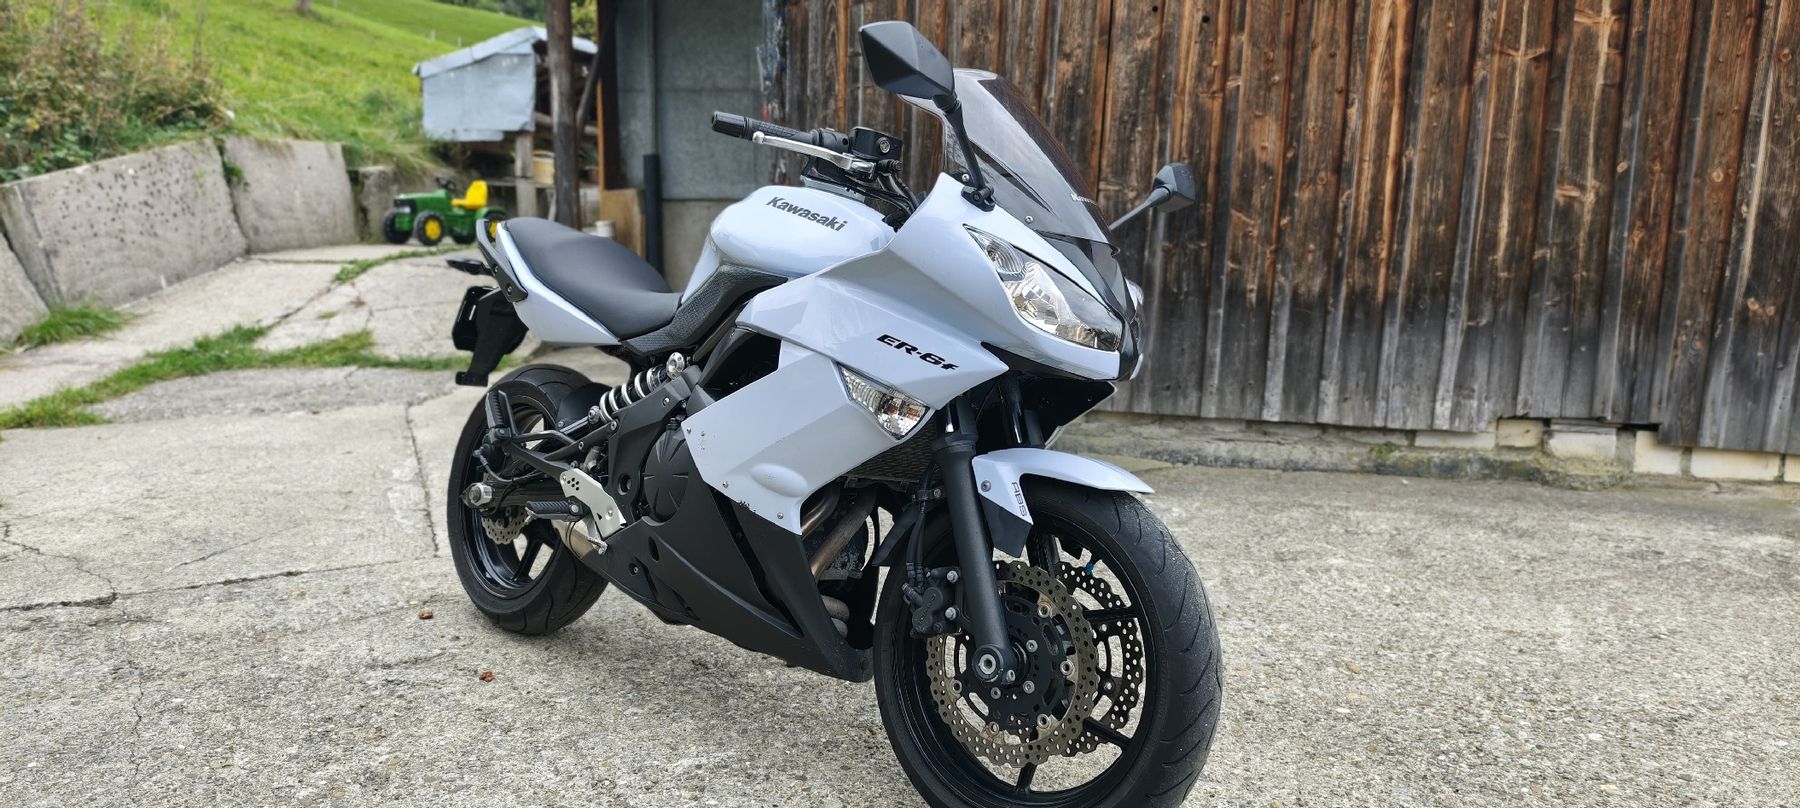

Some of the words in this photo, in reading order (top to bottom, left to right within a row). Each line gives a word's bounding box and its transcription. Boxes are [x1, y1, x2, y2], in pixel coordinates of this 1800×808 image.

[766, 196, 848, 232] Kawasaki
[876, 334, 960, 371] ER-6f
[1011, 481, 1028, 517] ABS
